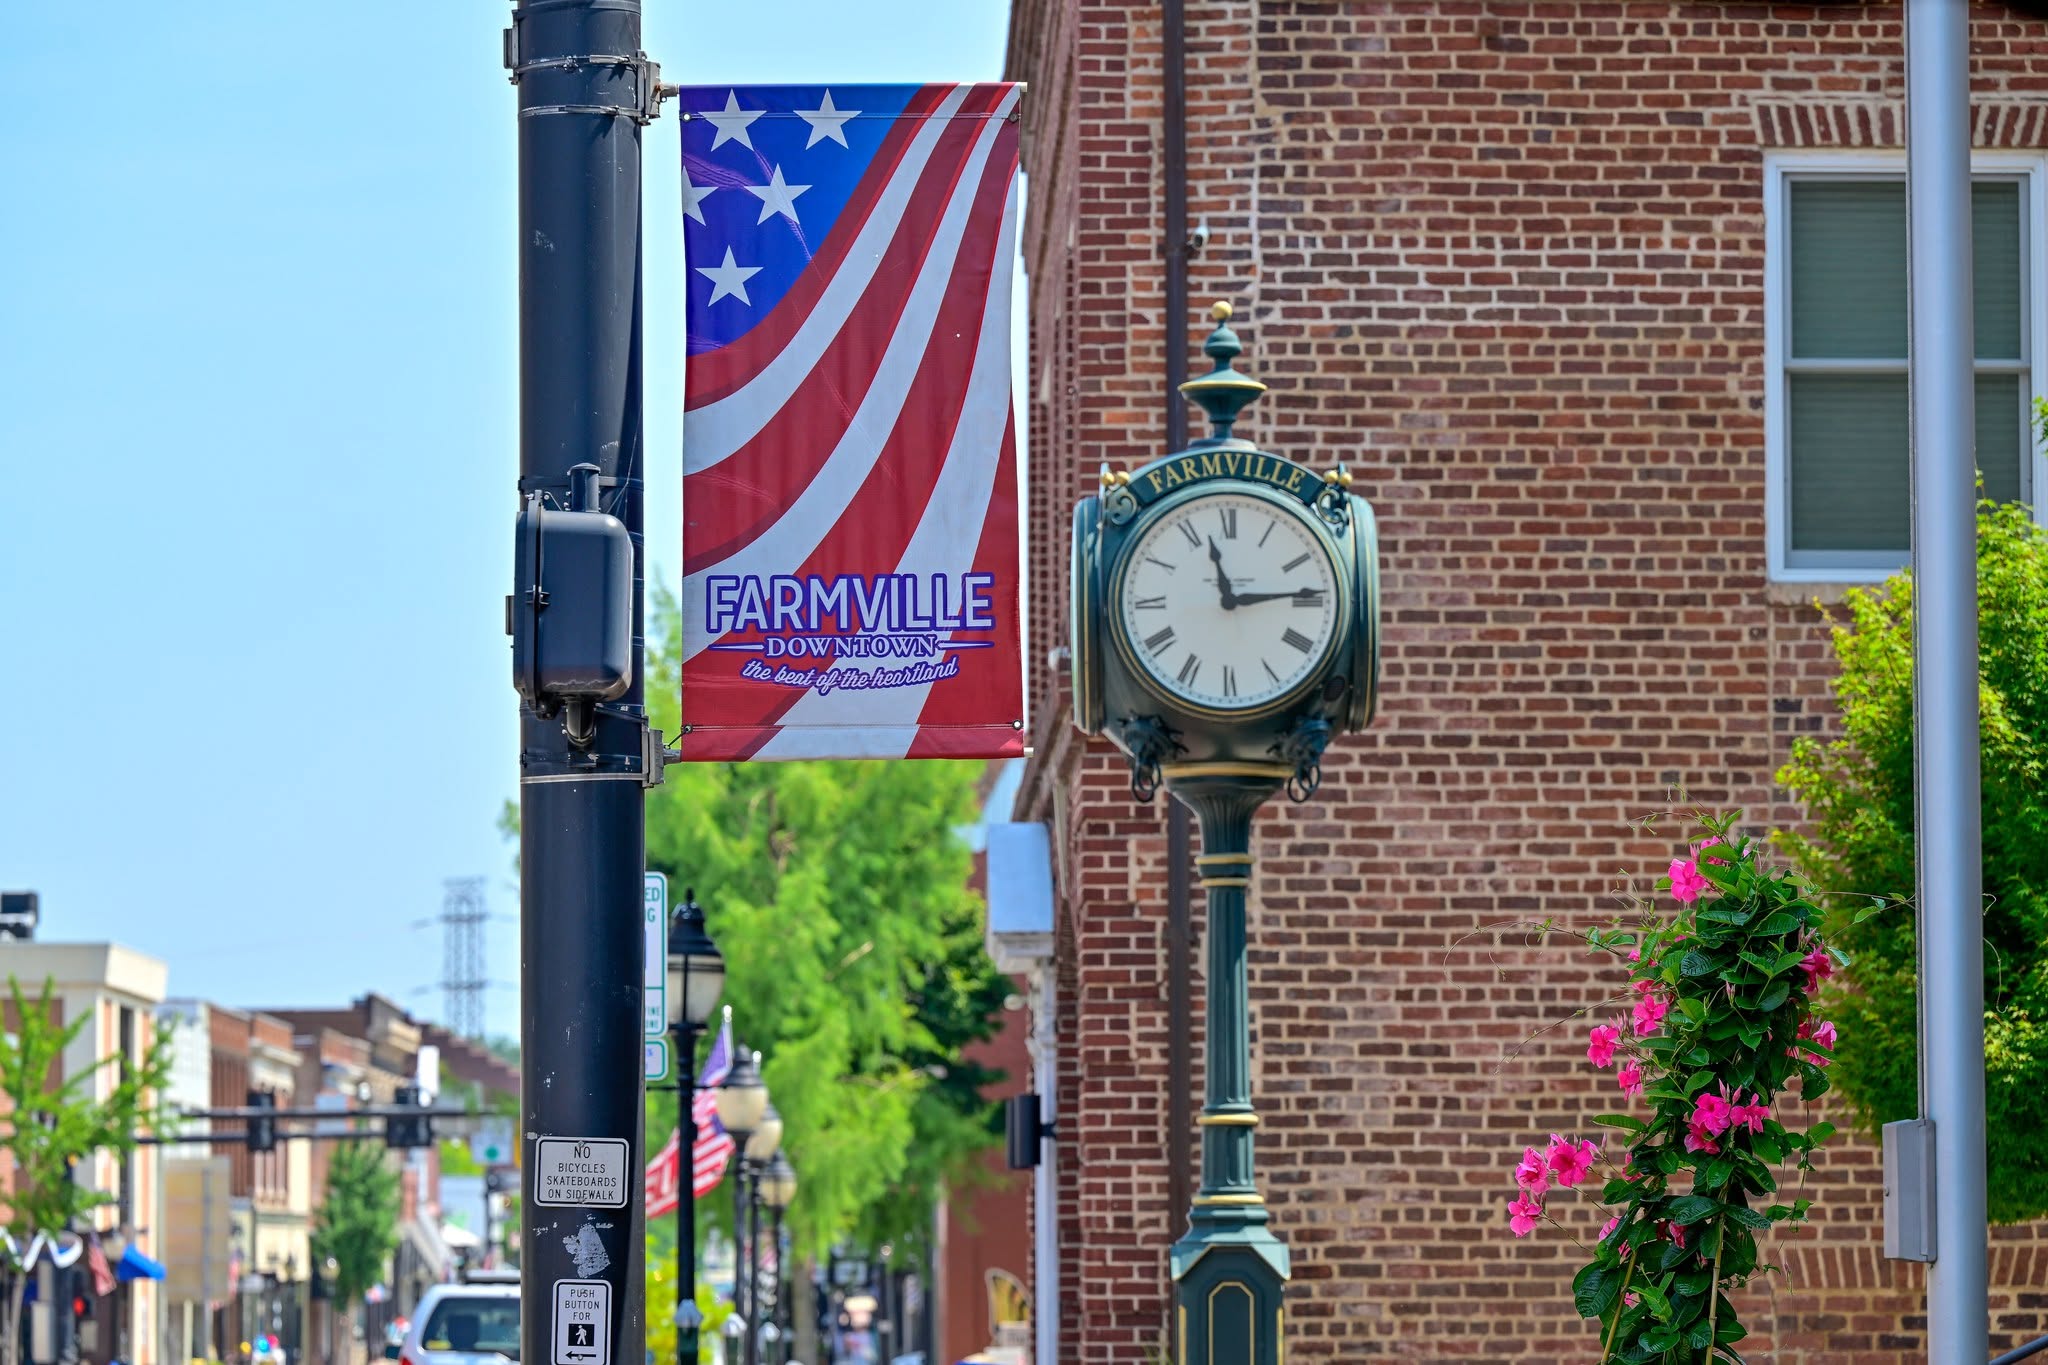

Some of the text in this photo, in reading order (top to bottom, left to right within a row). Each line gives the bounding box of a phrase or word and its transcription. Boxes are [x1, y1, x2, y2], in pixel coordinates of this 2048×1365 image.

[1146, 453, 1306, 494] FARMVILLE
[706, 573, 995, 633] FARMVILLE
[766, 635, 938, 658] DOWNTOWN
[742, 657, 958, 695] the beat of the heartland
[574, 1146, 591, 1159] NO
[558, 1163, 606, 1174] BICYCLES
[546, 1175, 617, 1187] SKATEBOARDS
[548, 1189, 614, 1200] ON SIDEWALK
[570, 1289, 595, 1298] PUSH
[564, 1300, 600, 1310] BUTTON
[573, 1312, 591, 1321] FOR
